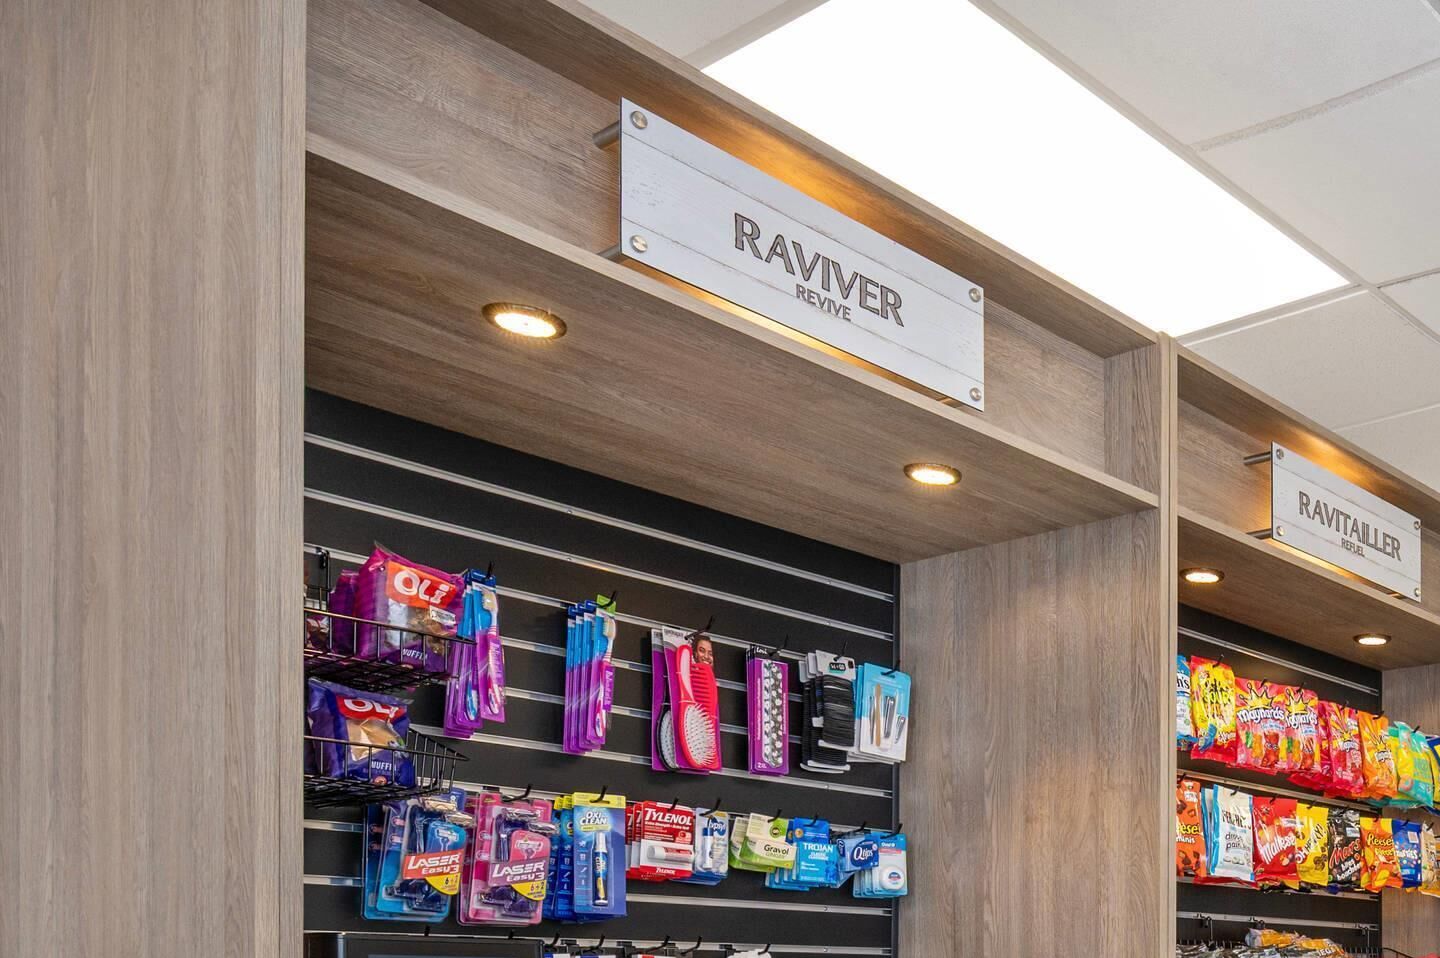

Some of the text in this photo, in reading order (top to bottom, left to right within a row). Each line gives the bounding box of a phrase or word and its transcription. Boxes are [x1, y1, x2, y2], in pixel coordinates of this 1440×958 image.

[734, 212, 904, 327] RAVIVER
[796, 283, 851, 321] REVIVE
[1298, 490, 1402, 561] RAVITAILLER
[1341, 537, 1365, 557] REFUEL
[644, 808, 692, 826] TYLENOL
[763, 843, 790, 856] Gravol
[803, 843, 833, 852] TROJAN
[407, 853, 461, 871] LASER
[492, 861, 546, 878] LASER
